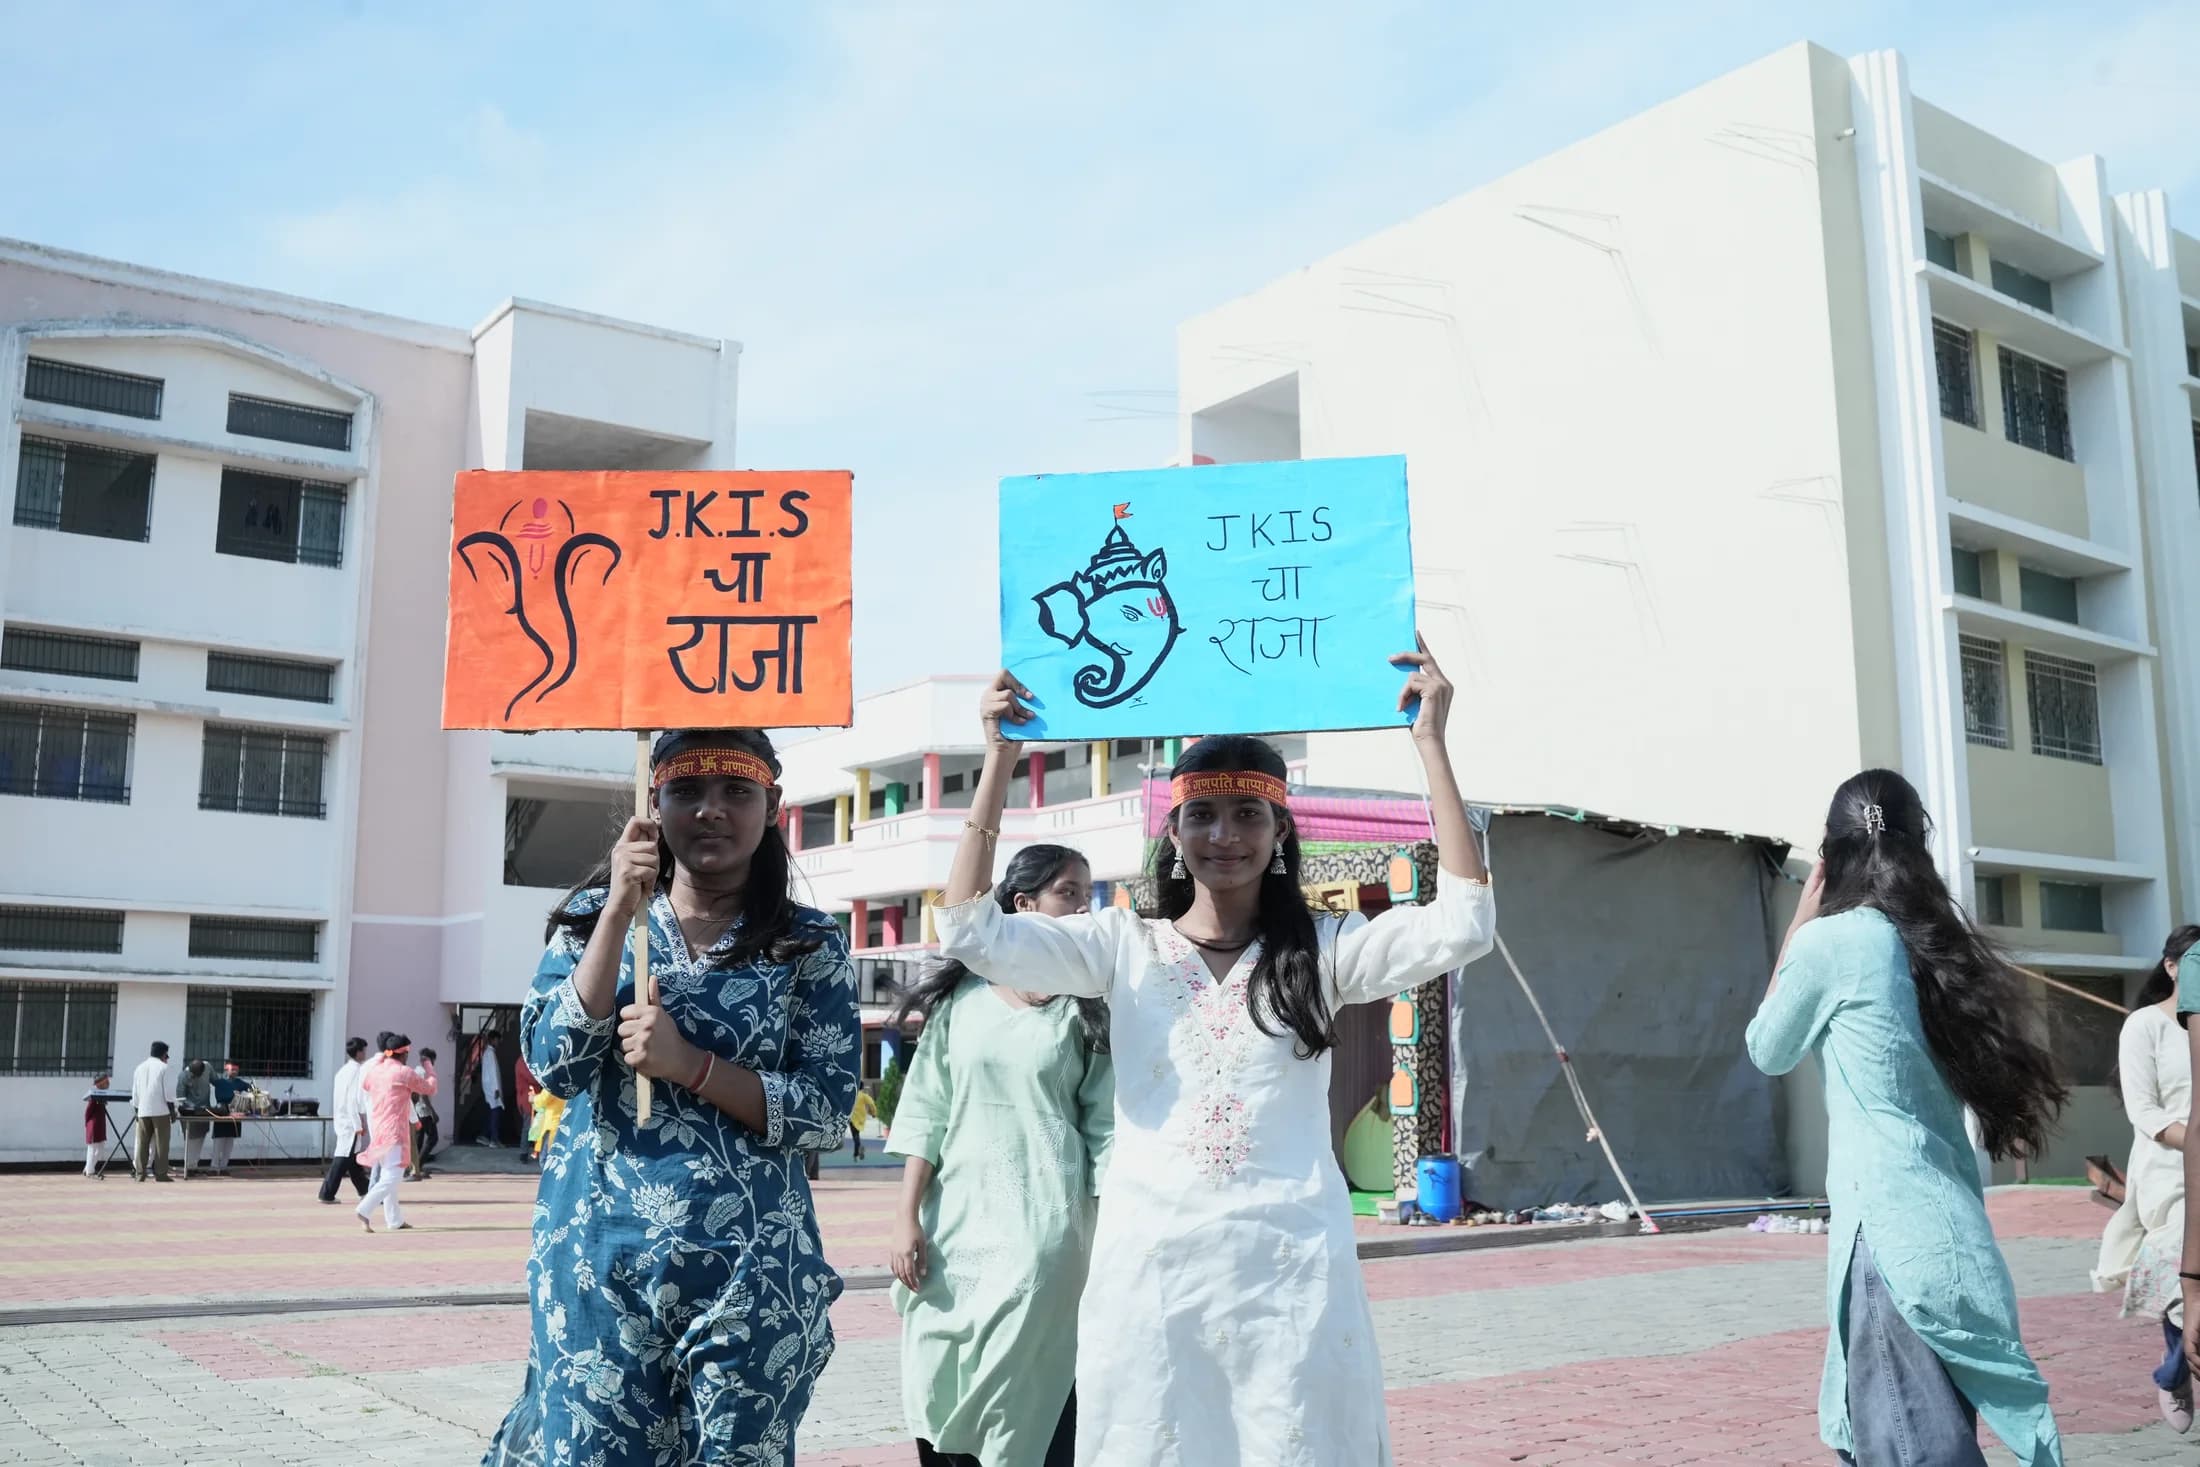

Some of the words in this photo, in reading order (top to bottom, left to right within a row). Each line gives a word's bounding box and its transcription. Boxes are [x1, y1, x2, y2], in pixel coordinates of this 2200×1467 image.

[648, 490, 810, 539] J.K.I.S
[704, 552, 771, 602] चा
[1251, 566, 1312, 602] चा
[667, 616, 818, 694] राजा
[1209, 615, 1336, 676] राजा
[1193, 772, 1233, 791] गणपति
